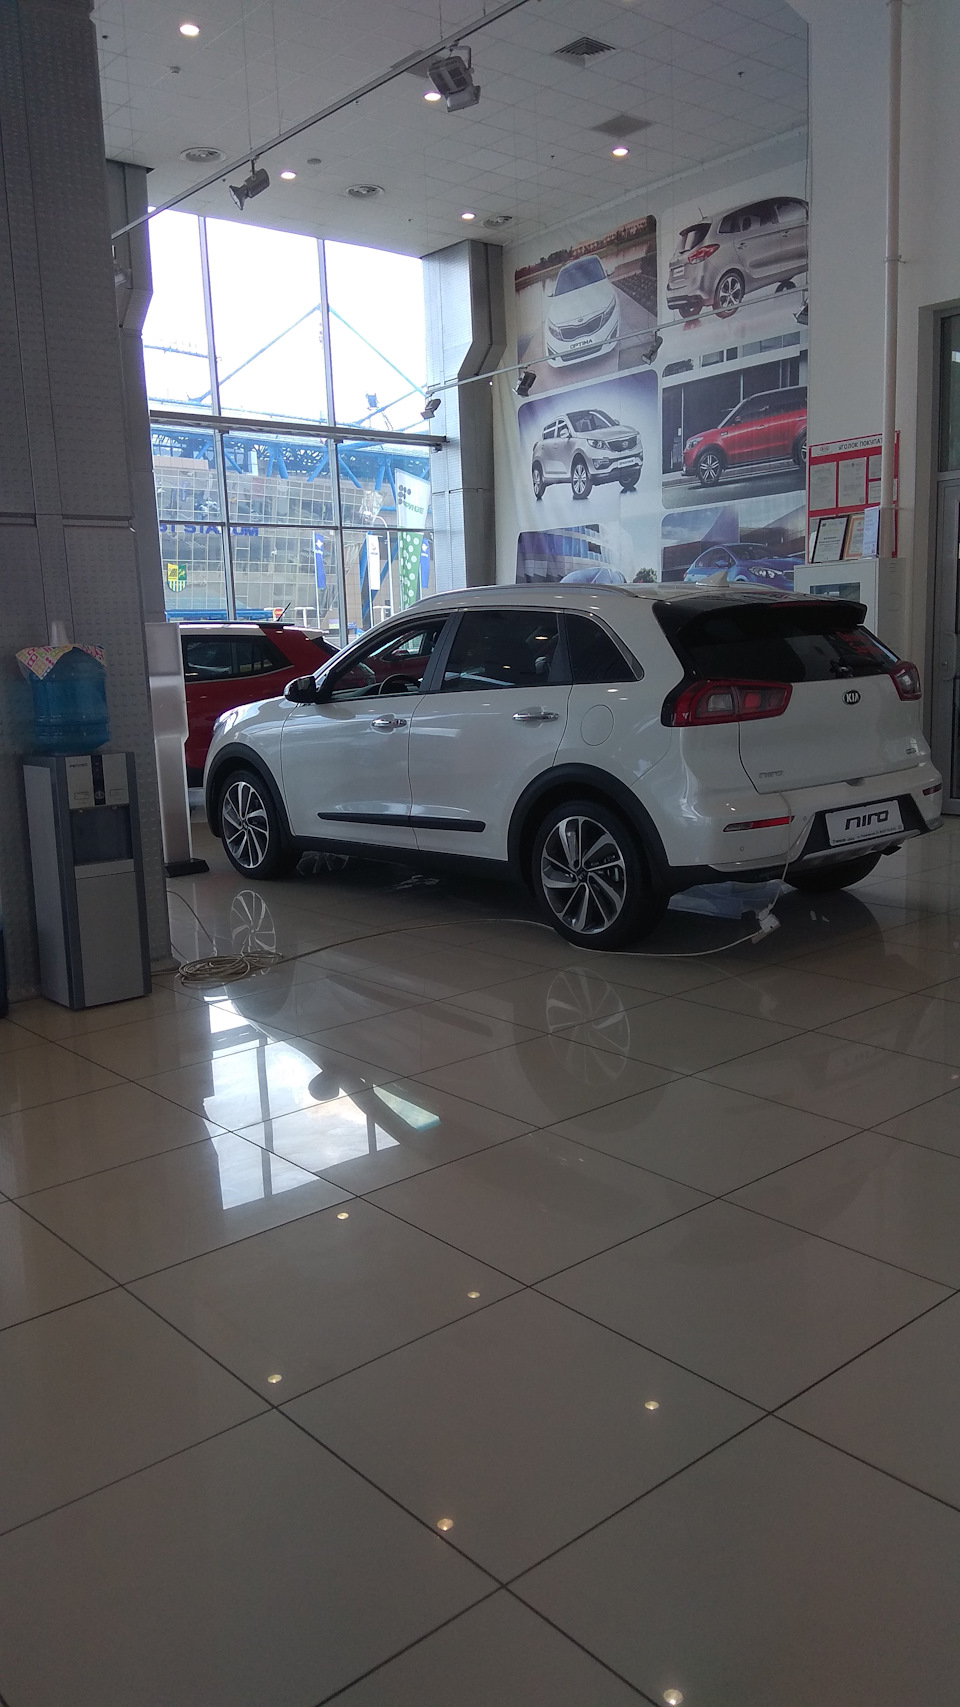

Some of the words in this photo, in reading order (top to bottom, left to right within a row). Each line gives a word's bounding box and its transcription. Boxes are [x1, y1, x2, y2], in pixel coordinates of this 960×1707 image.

[569, 339, 593, 350] OPTIMA
[860, 437, 883, 449] ПОКУПАТ
[845, 692, 860, 703] KIA
